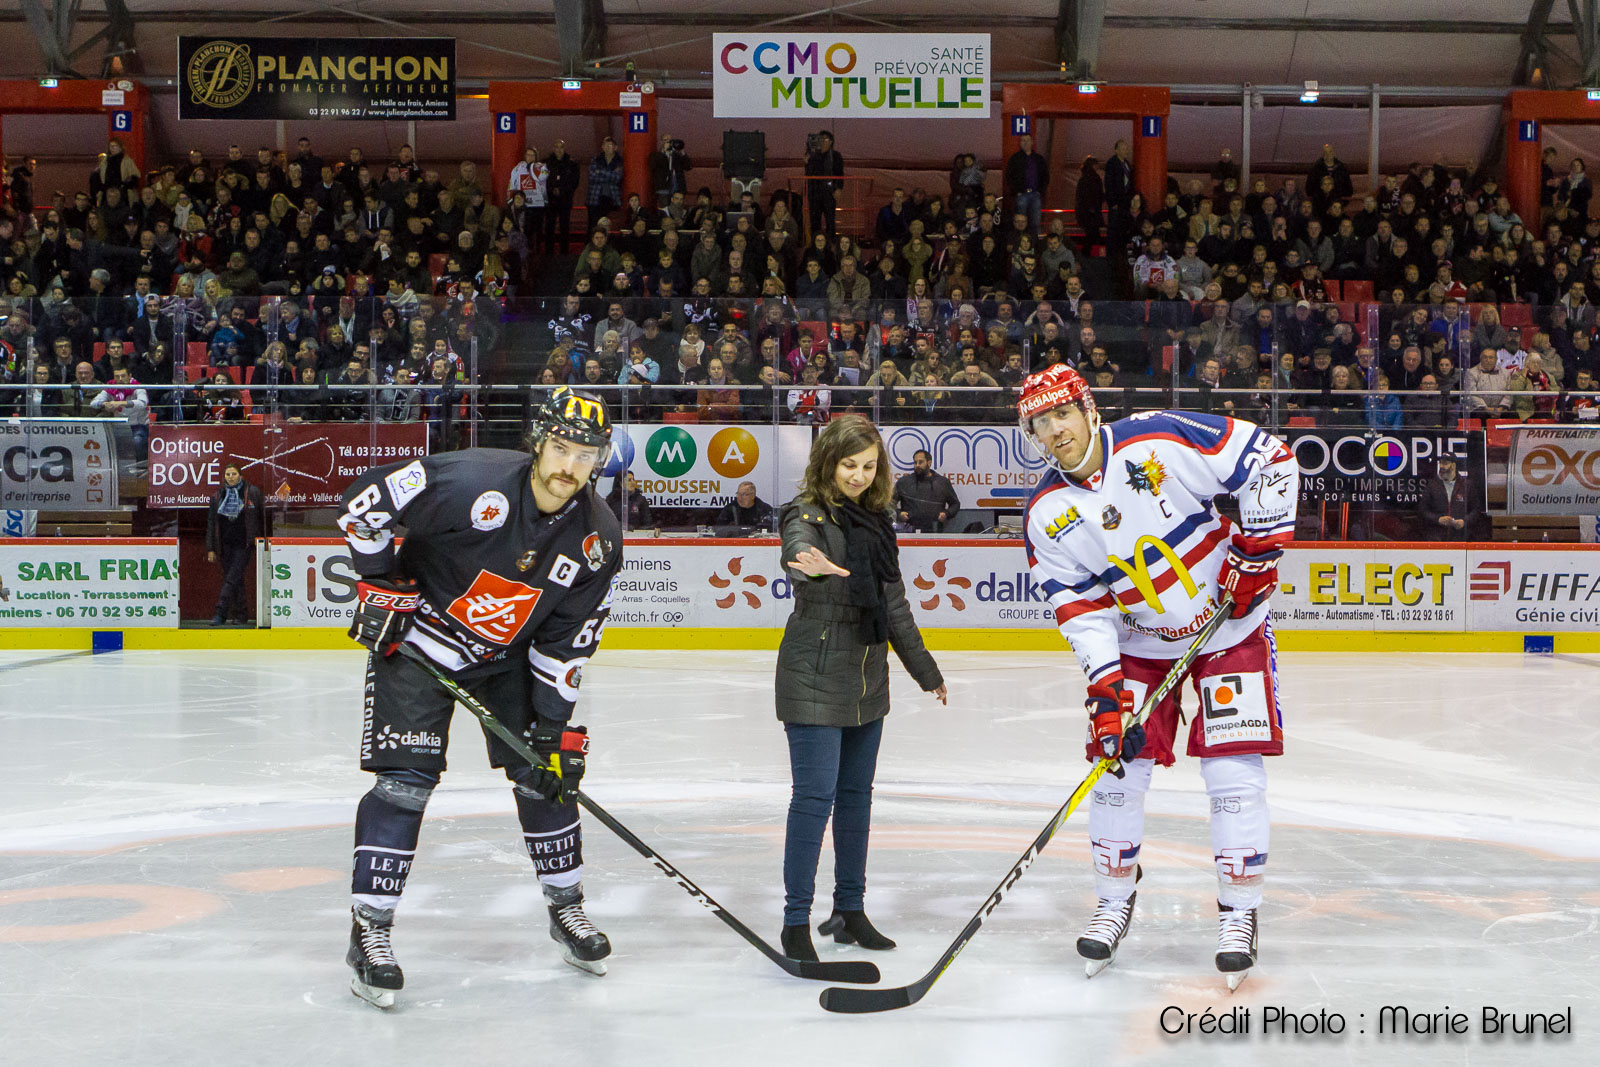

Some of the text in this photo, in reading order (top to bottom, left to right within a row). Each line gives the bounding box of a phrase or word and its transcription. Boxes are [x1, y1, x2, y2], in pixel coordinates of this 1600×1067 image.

[720, 42, 857, 74] CCMO
[931, 45, 984, 60] SANTÉ
[257, 55, 448, 81] PLANCHON
[874, 59, 984, 75] PRÉVOYANCE
[257, 83, 448, 93] FROMAGER AFFINEUR
[771, 77, 984, 109] MUTUELLE
[370, 99, 379, 107] La
[380, 99, 396, 107] Halle
[407, 99, 424, 108] frais,
[368, 108, 448, 117] www.julienplanchon.com
[115, 113, 126, 128] G
[500, 115, 511, 131] G
[633, 115, 644, 130] H
[1016, 118, 1026, 133] H
[1020, 387, 1070, 418] MédiAlpes
[1526, 430, 1597, 439] PARTENAIRE
[151, 438, 224, 457] Optique
[338, 446, 424, 456] Tél. 03 22 33 06 16
[656, 441, 686, 463] M
[152, 458, 220, 486] BOVÉ
[338, 466, 354, 476] Fax
[5, 491, 71, 502] d'entreprise
[149, 495, 163, 504] 115,
[177, 495, 210, 503] Alexandre
[313, 493, 333, 502] Vallée
[334, 494, 343, 502] de
[659, 496, 700, 506] Leclerc
[1521, 494, 1572, 504] Solutions
[348, 484, 393, 529] 64
[1160, 499, 1172, 519] C
[17, 562, 89, 581] SARL
[557, 563, 571, 580] C
[1309, 563, 1454, 606] ELECT
[17, 591, 70, 600] Location
[82, 590, 168, 600] Terrassement
[651, 596, 690, 605] Coquelles
[56, 607, 74, 617] 06
[79, 607, 97, 617] 70
[102, 607, 120, 617] 92
[126, 607, 143, 617] 95
[148, 606, 166, 617] 46
[273, 606, 291, 617] 36
[307, 607, 340, 618] Votre
[998, 609, 1039, 620] GROUPE
[1269, 609, 1287, 621] ique
[1293, 609, 1319, 620] Alarme
[1326, 609, 1374, 620] Automatisme
[1381, 610, 1395, 620] TEL
[1401, 610, 1411, 621] 03
[1412, 610, 1422, 621] 22
[1423, 610, 1433, 621] 92
[1434, 610, 1443, 621] 18
[1445, 610, 1454, 621] 61
[1516, 607, 1565, 622] Génie
[361, 696, 375, 760] FORUM
[1206, 719, 1269, 735] groupeAGDA
[401, 731, 441, 747] dalkia
[1206, 730, 1270, 741] immobilier
[535, 833, 575, 855] PETIT
[370, 856, 394, 871] LE
